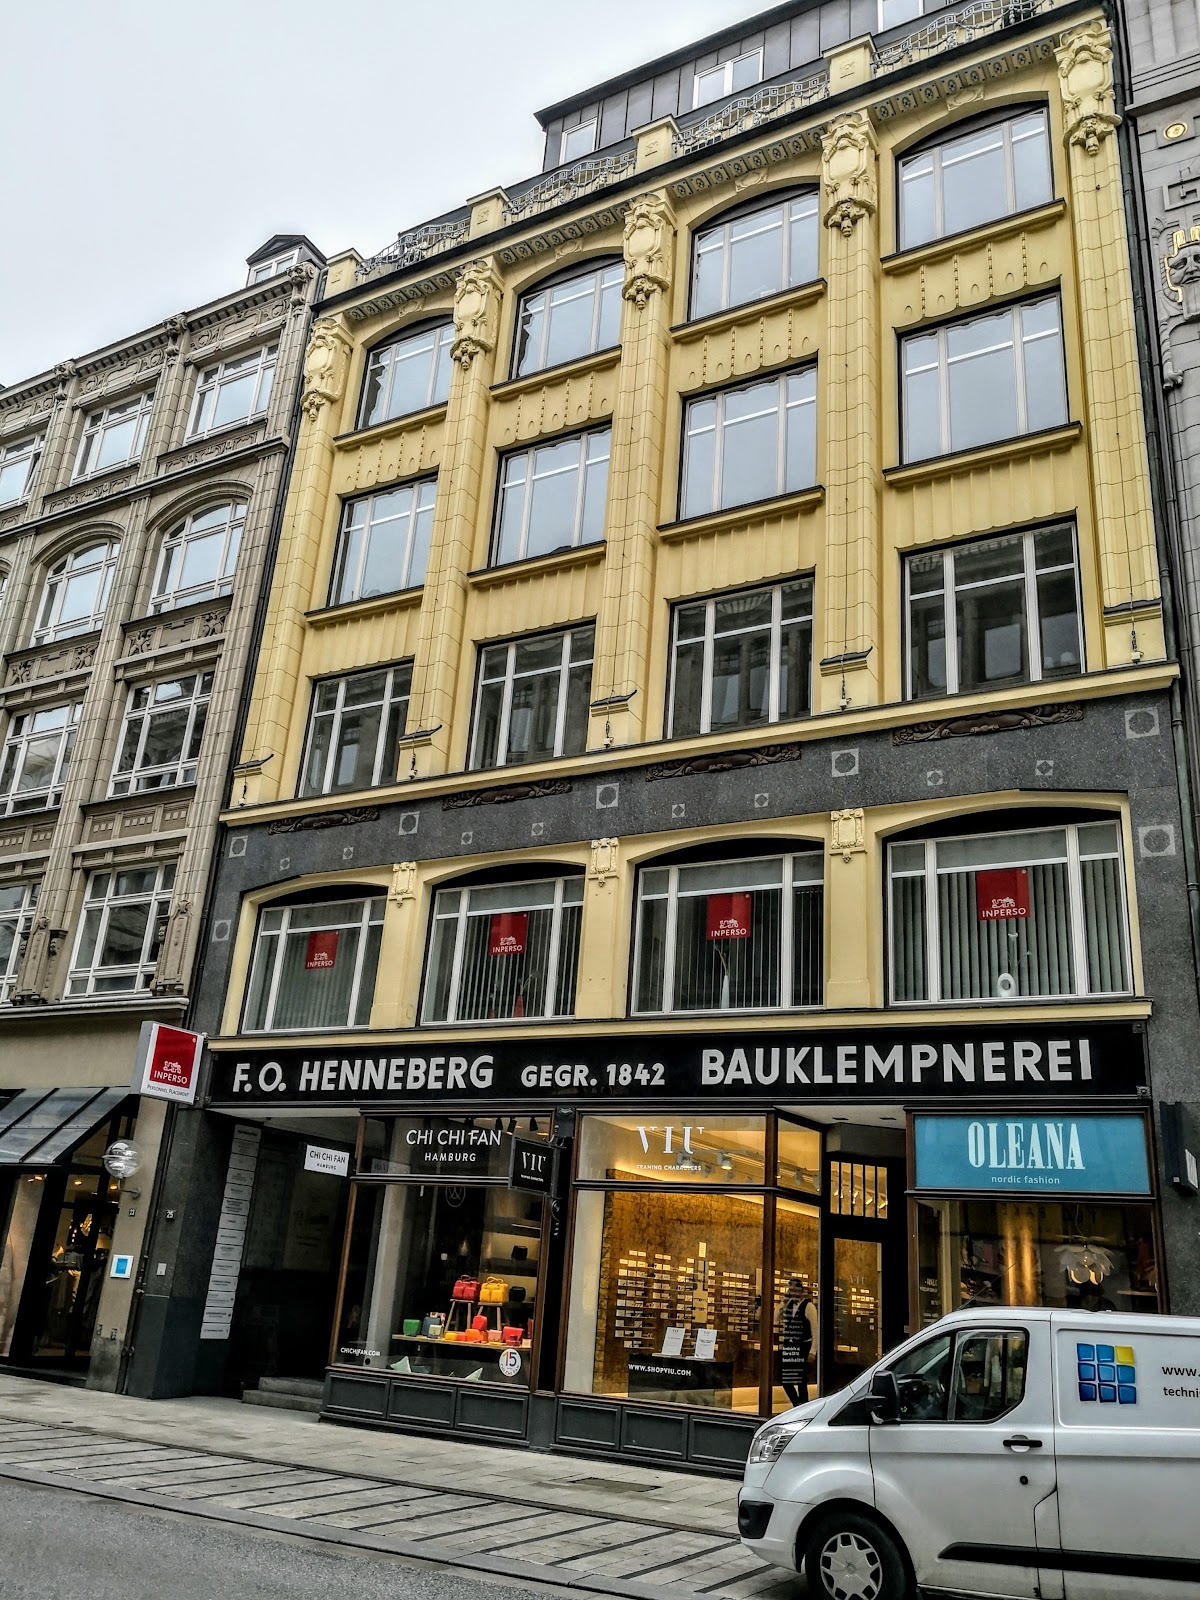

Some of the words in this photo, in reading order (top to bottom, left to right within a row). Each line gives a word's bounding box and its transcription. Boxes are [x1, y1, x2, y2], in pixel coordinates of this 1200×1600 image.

[982, 907, 1026, 918] INPERSO
[711, 928, 747, 937] INPERSO
[492, 944, 523, 953] INPERSO
[307, 960, 333, 968] INPERSO
[702, 1039, 1092, 1085] BAUKLEMPNEREI
[153, 1070, 188, 1085] INPERSO
[233, 1063, 252, 1093] F.
[258, 1061, 287, 1092] O.
[299, 1055, 494, 1091] HENNEBERG
[521, 1065, 597, 1088] GEGR.
[606, 1063, 665, 1086] 1842
[406, 1130, 433, 1145] CHI
[437, 1130, 465, 1145] CHI
[469, 1130, 502, 1146] FAN
[636, 1126, 705, 1155] VIU
[967, 1121, 1086, 1170] OLEANA
[309, 1150, 321, 1160] CHI
[321, 1152, 333, 1162] CHI
[333, 1154, 346, 1164] FAN
[424, 1152, 477, 1162] HAMBURG
[521, 1151, 547, 1173] VIU
[991, 1175, 1021, 1184] nordic
[1024, 1175, 1060, 1185] fashion
[502, 1352, 517, 1367] 15
[627, 1363, 692, 1376] WWW.SHOPVIU.COM
[1163, 1386, 1200, 1398] techni
